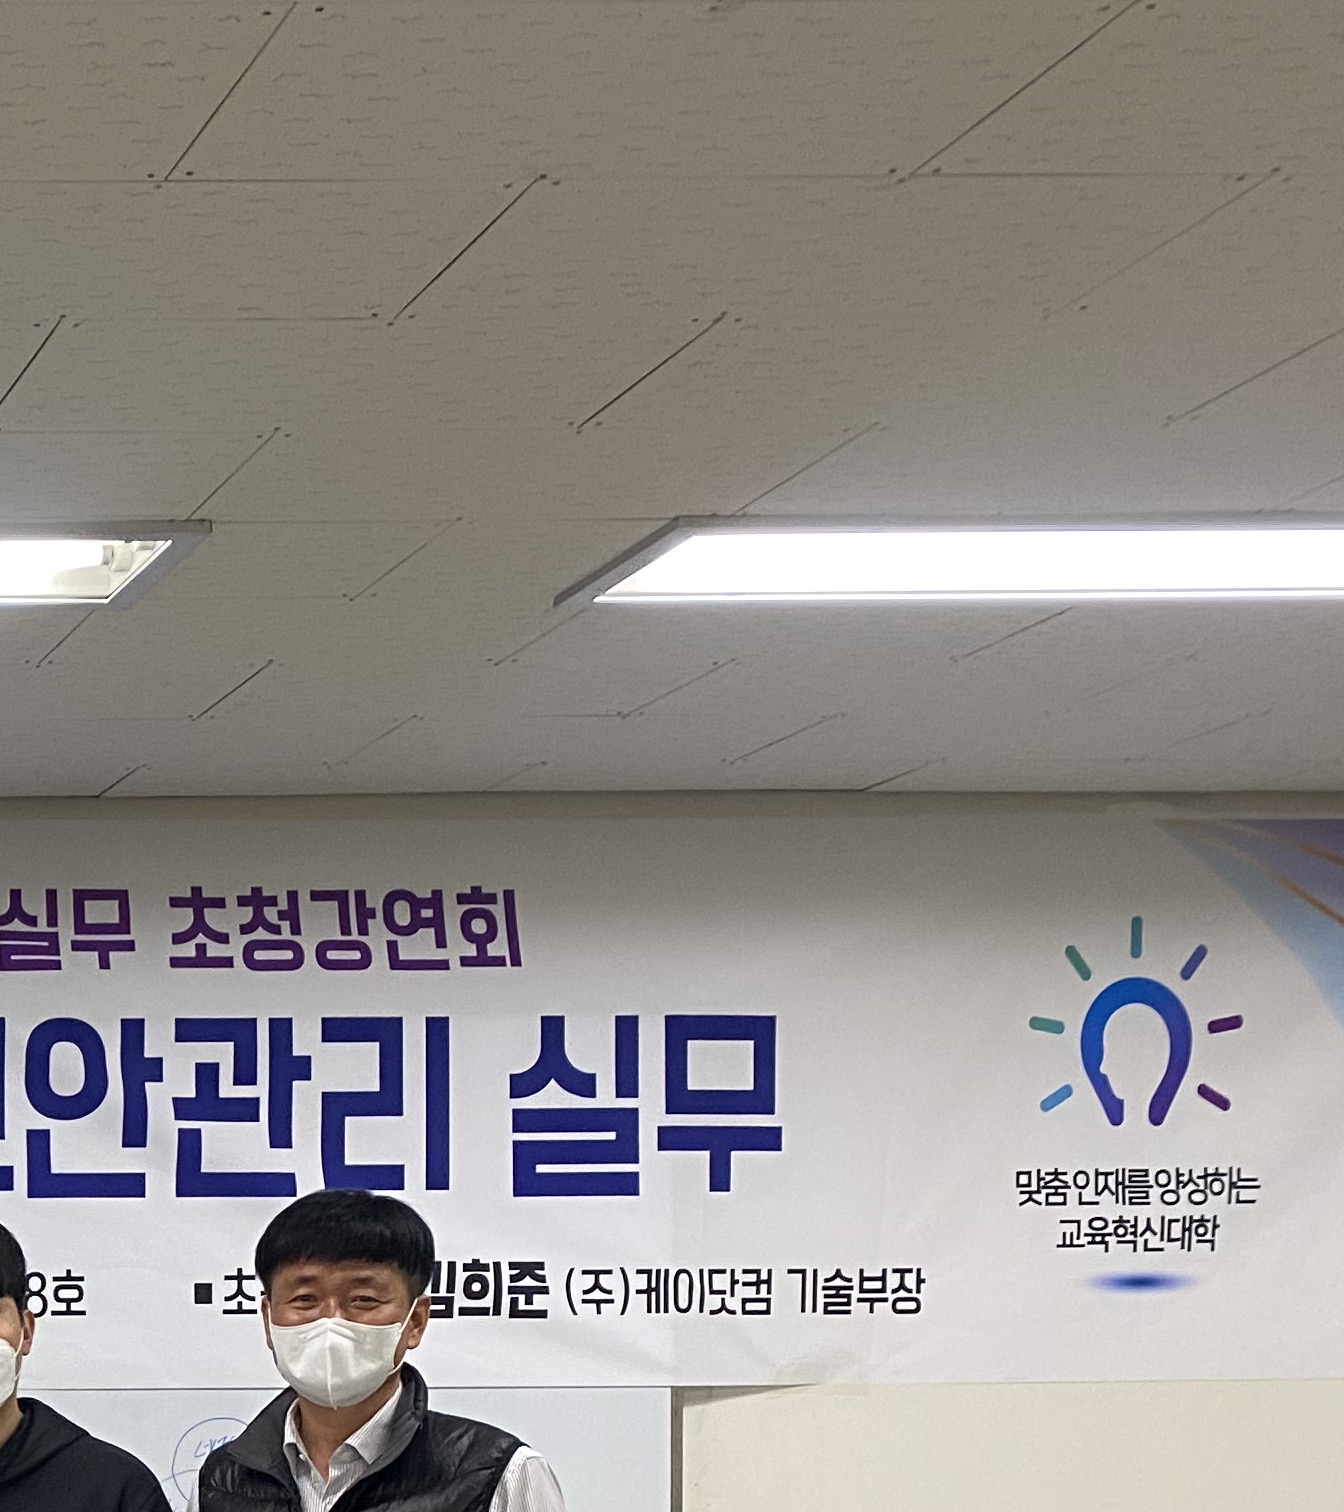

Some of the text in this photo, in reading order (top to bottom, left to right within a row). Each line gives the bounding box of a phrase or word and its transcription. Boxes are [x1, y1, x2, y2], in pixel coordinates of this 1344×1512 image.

[168, 885, 524, 972] 초청강연회
[509, 1013, 784, 1198] 실무
[786, 1266, 926, 1316] 기술부장
